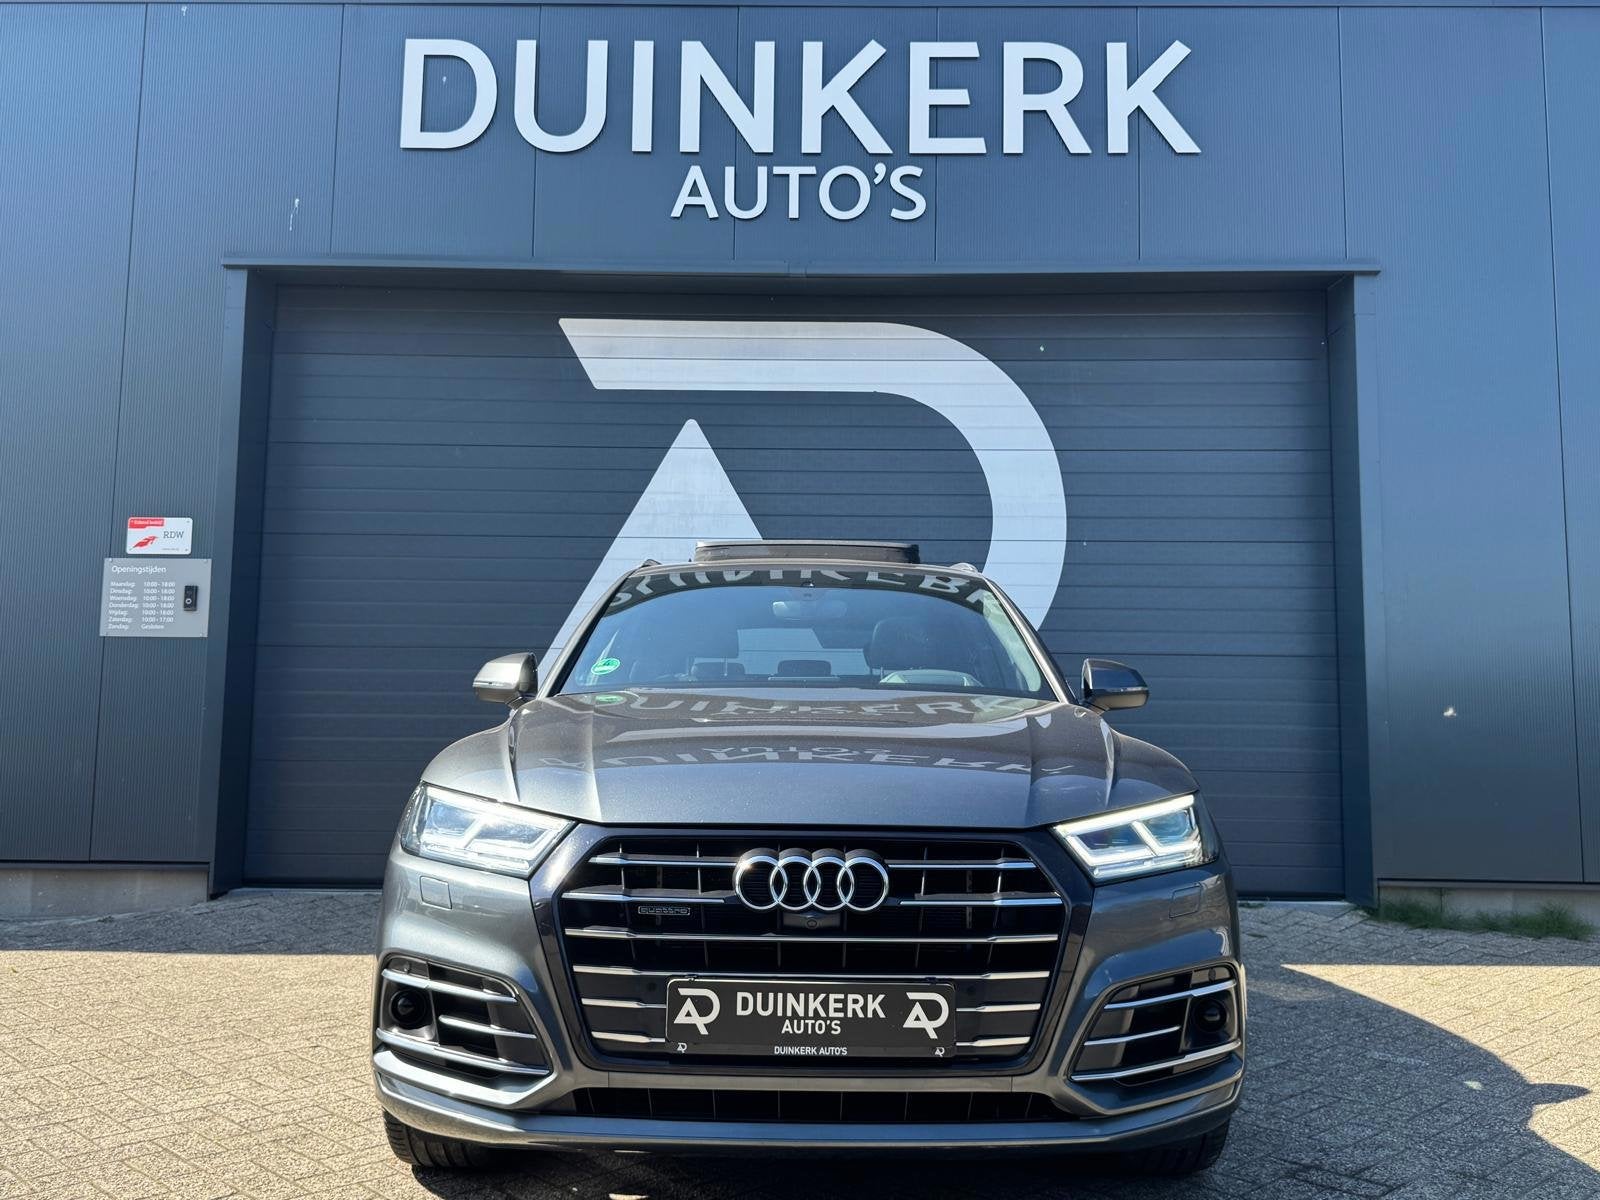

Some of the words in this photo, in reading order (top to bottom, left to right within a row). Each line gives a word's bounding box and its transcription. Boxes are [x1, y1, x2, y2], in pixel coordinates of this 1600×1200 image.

[399, 38, 1201, 155] DUINKERK
[671, 163, 927, 221] AUTO'S
[164, 530, 184, 539] RDW
[112, 566, 166, 574] Openingstijden
[735, 991, 886, 1018] DUINKERK
[781, 1019, 841, 1035] AUTO'S
[774, 1046, 817, 1055] DUINKERK
[819, 1046, 848, 1056] AUTO'S
